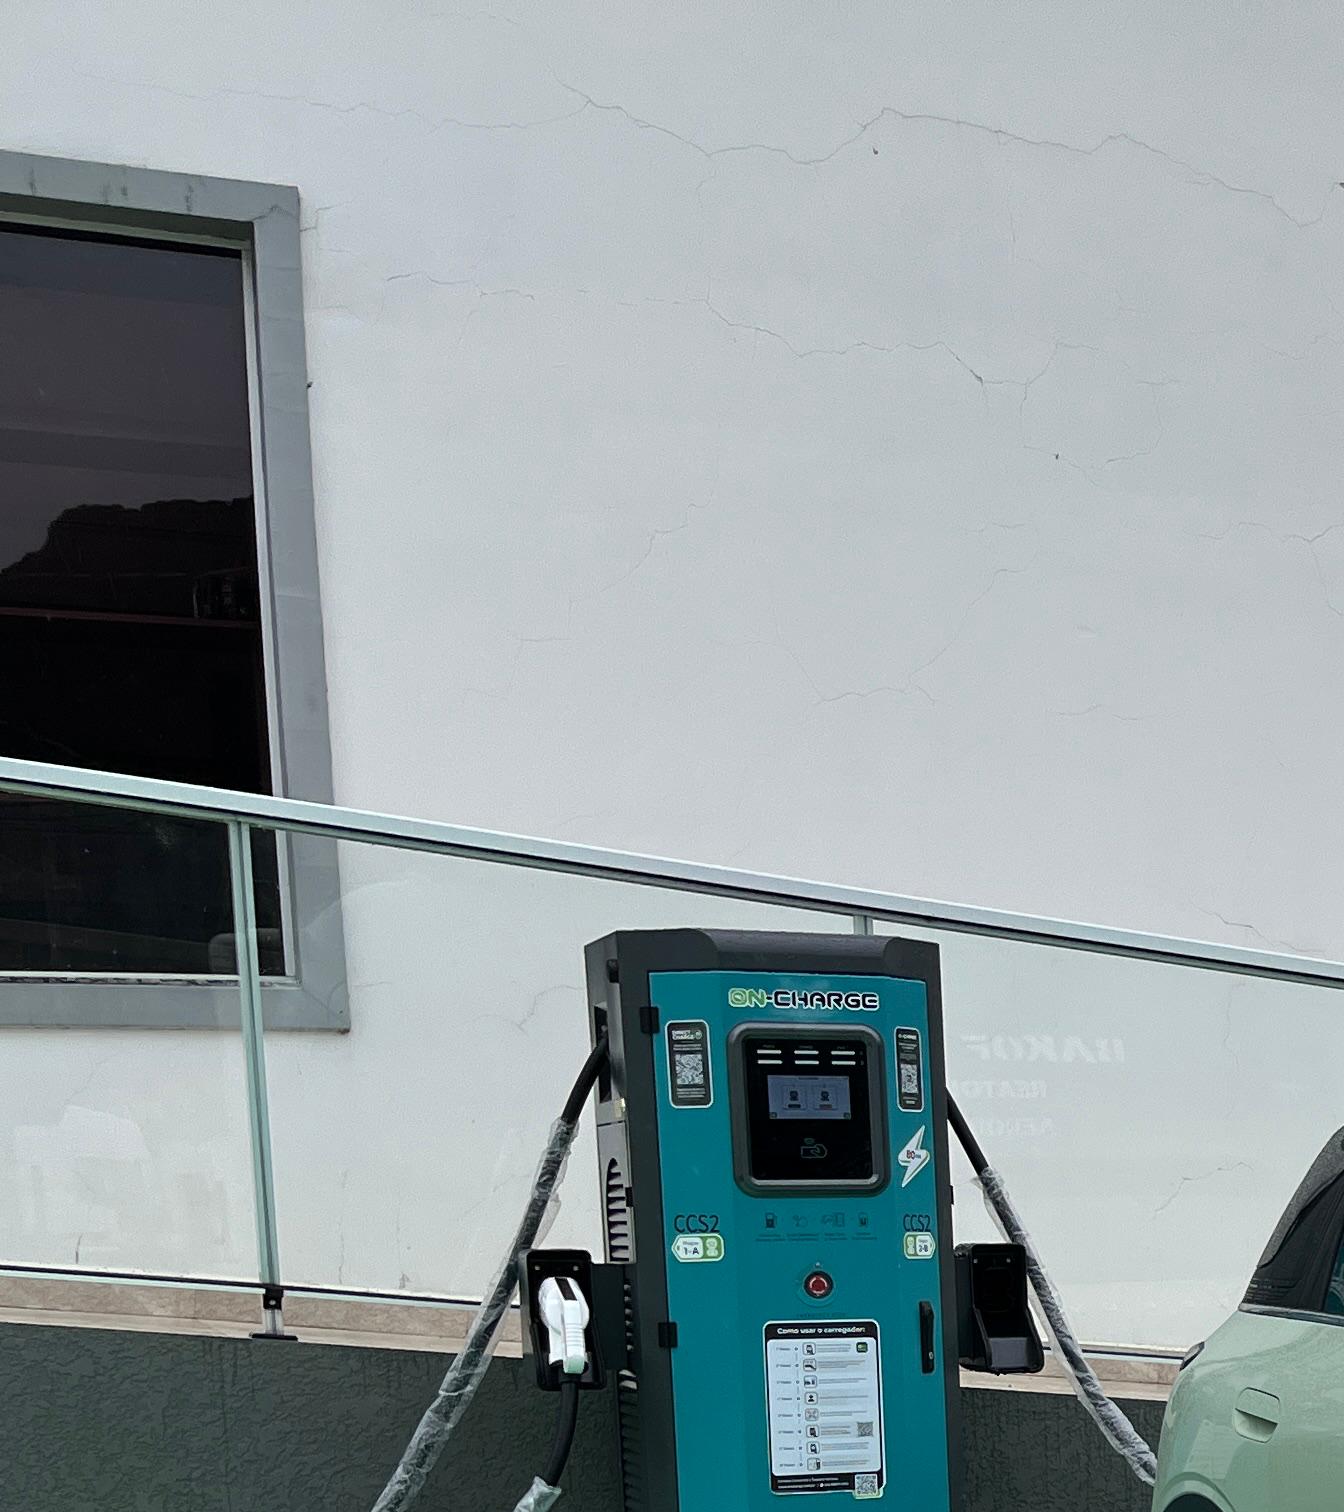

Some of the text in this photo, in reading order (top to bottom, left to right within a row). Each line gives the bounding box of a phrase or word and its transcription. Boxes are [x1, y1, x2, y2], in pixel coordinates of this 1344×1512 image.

[728, 987, 880, 1011] ON-CHARGE
[674, 1214, 720, 1234] CCS2
[903, 1213, 931, 1232] CCS2
[777, 1327, 800, 1335] Como
